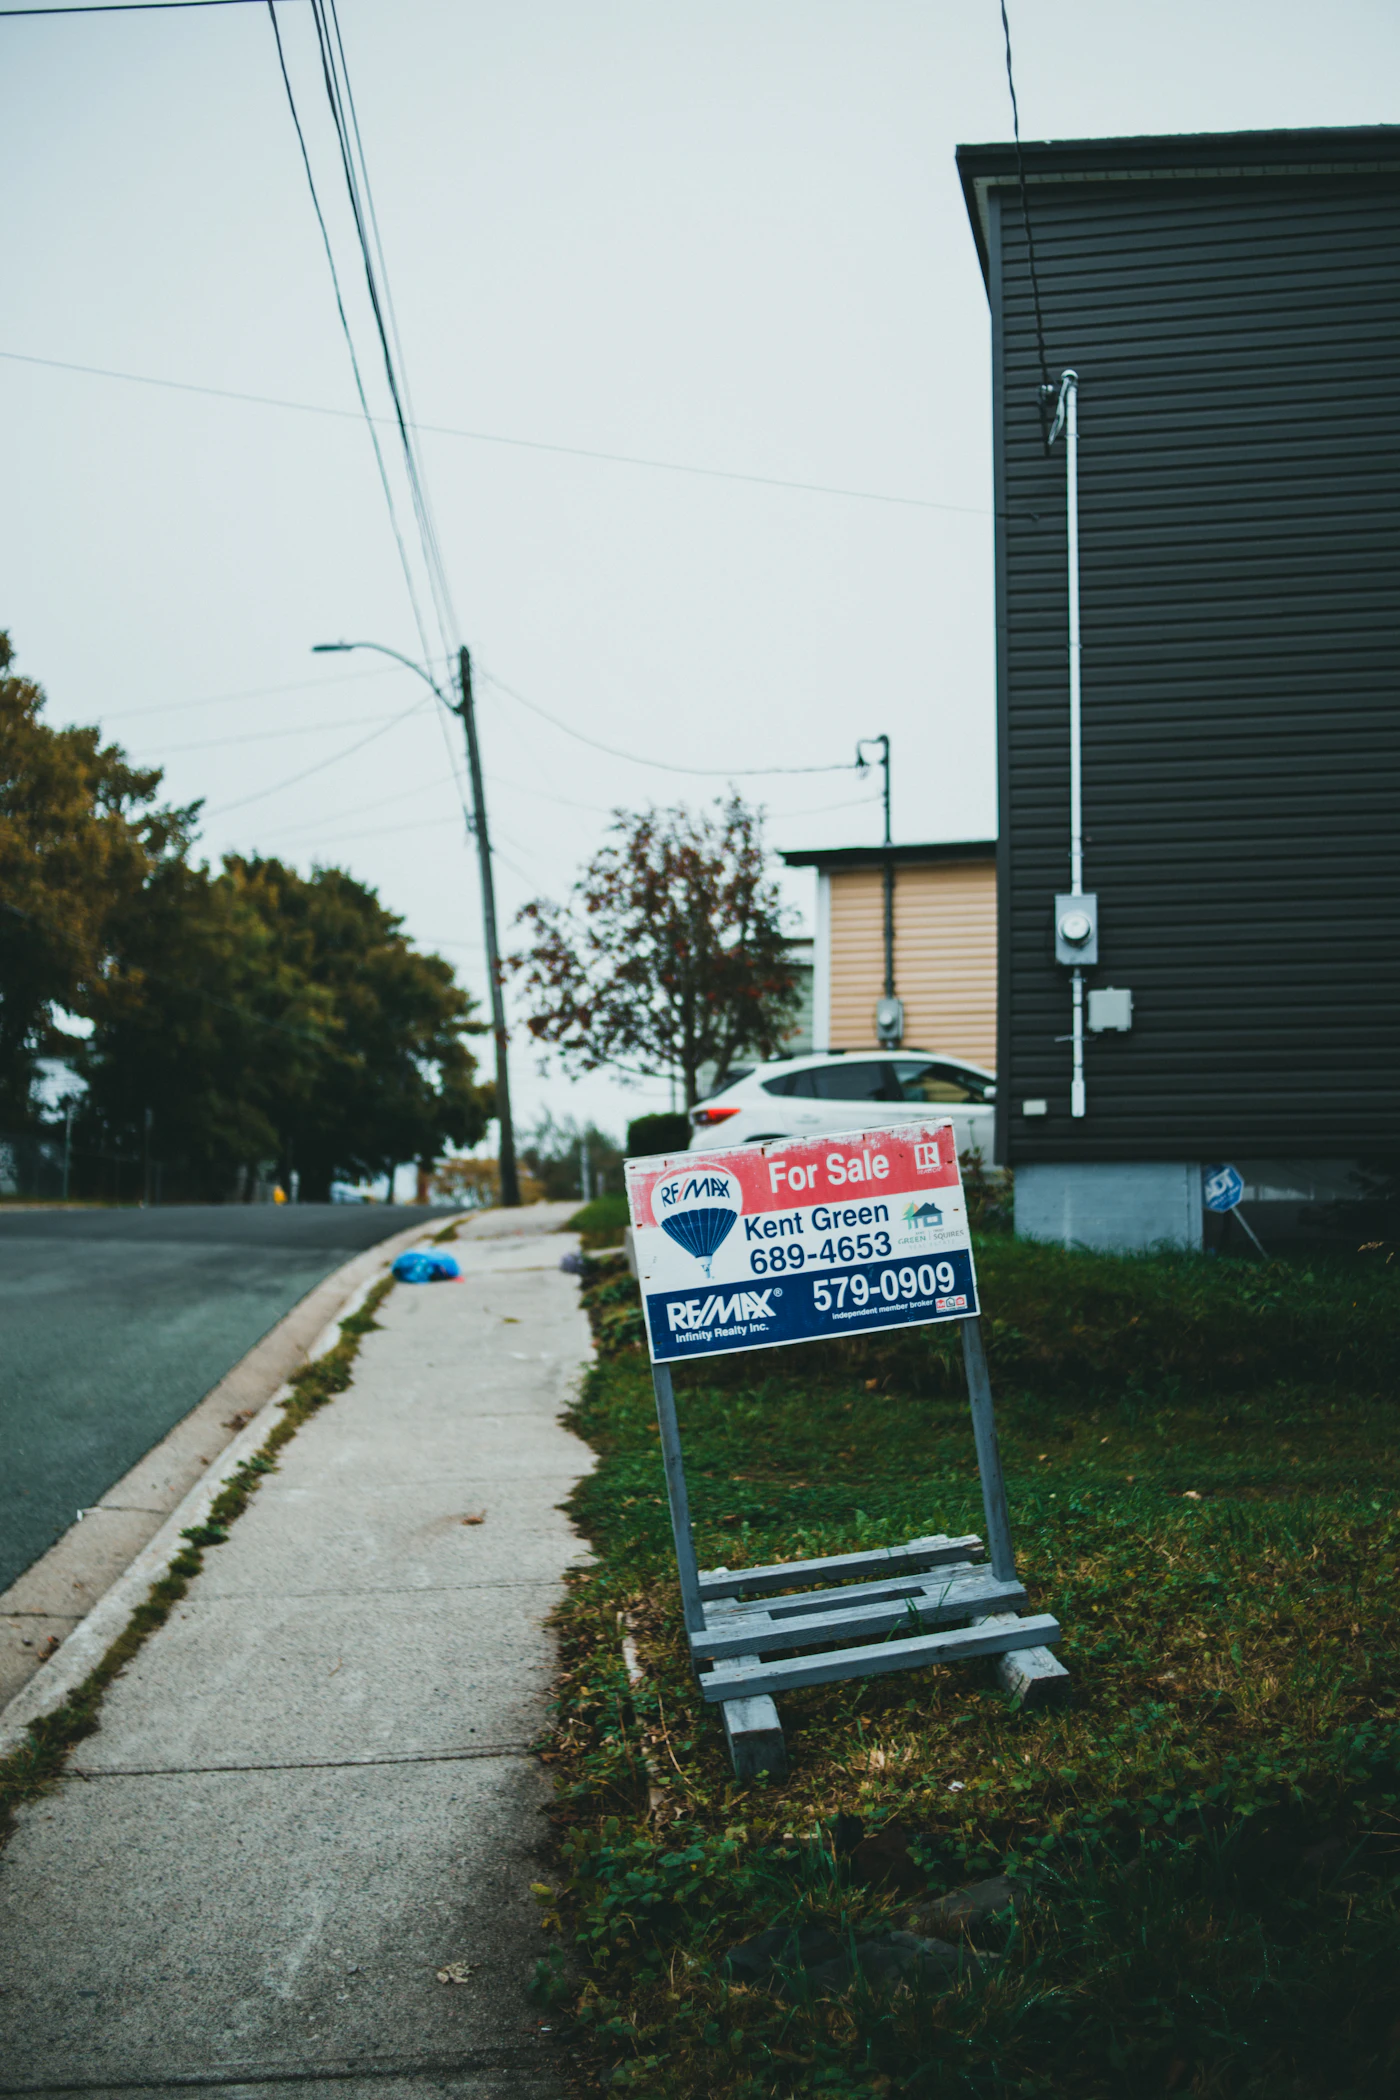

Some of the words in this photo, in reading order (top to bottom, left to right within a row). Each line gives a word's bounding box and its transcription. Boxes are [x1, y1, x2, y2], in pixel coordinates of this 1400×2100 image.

[768, 1160, 818, 1194] For
[826, 1149, 890, 1185] Sale
[660, 1177, 731, 1208] RE/MAX
[744, 1212, 804, 1241] Kent
[811, 1204, 889, 1231] Green
[897, 1235, 927, 1245] GREEN
[933, 1229, 964, 1241] SQUIRES
[750, 1231, 892, 1274] 689-4653
[813, 1261, 955, 1311] 579-0909
[832, 1307, 878, 1320] independent
[878, 1303, 908, 1313] member
[909, 1299, 934, 1308] broker
[675, 1329, 713, 1343] Infinity
[714, 1325, 748, 1338] Realty
[749, 1323, 769, 1333] Inc.
